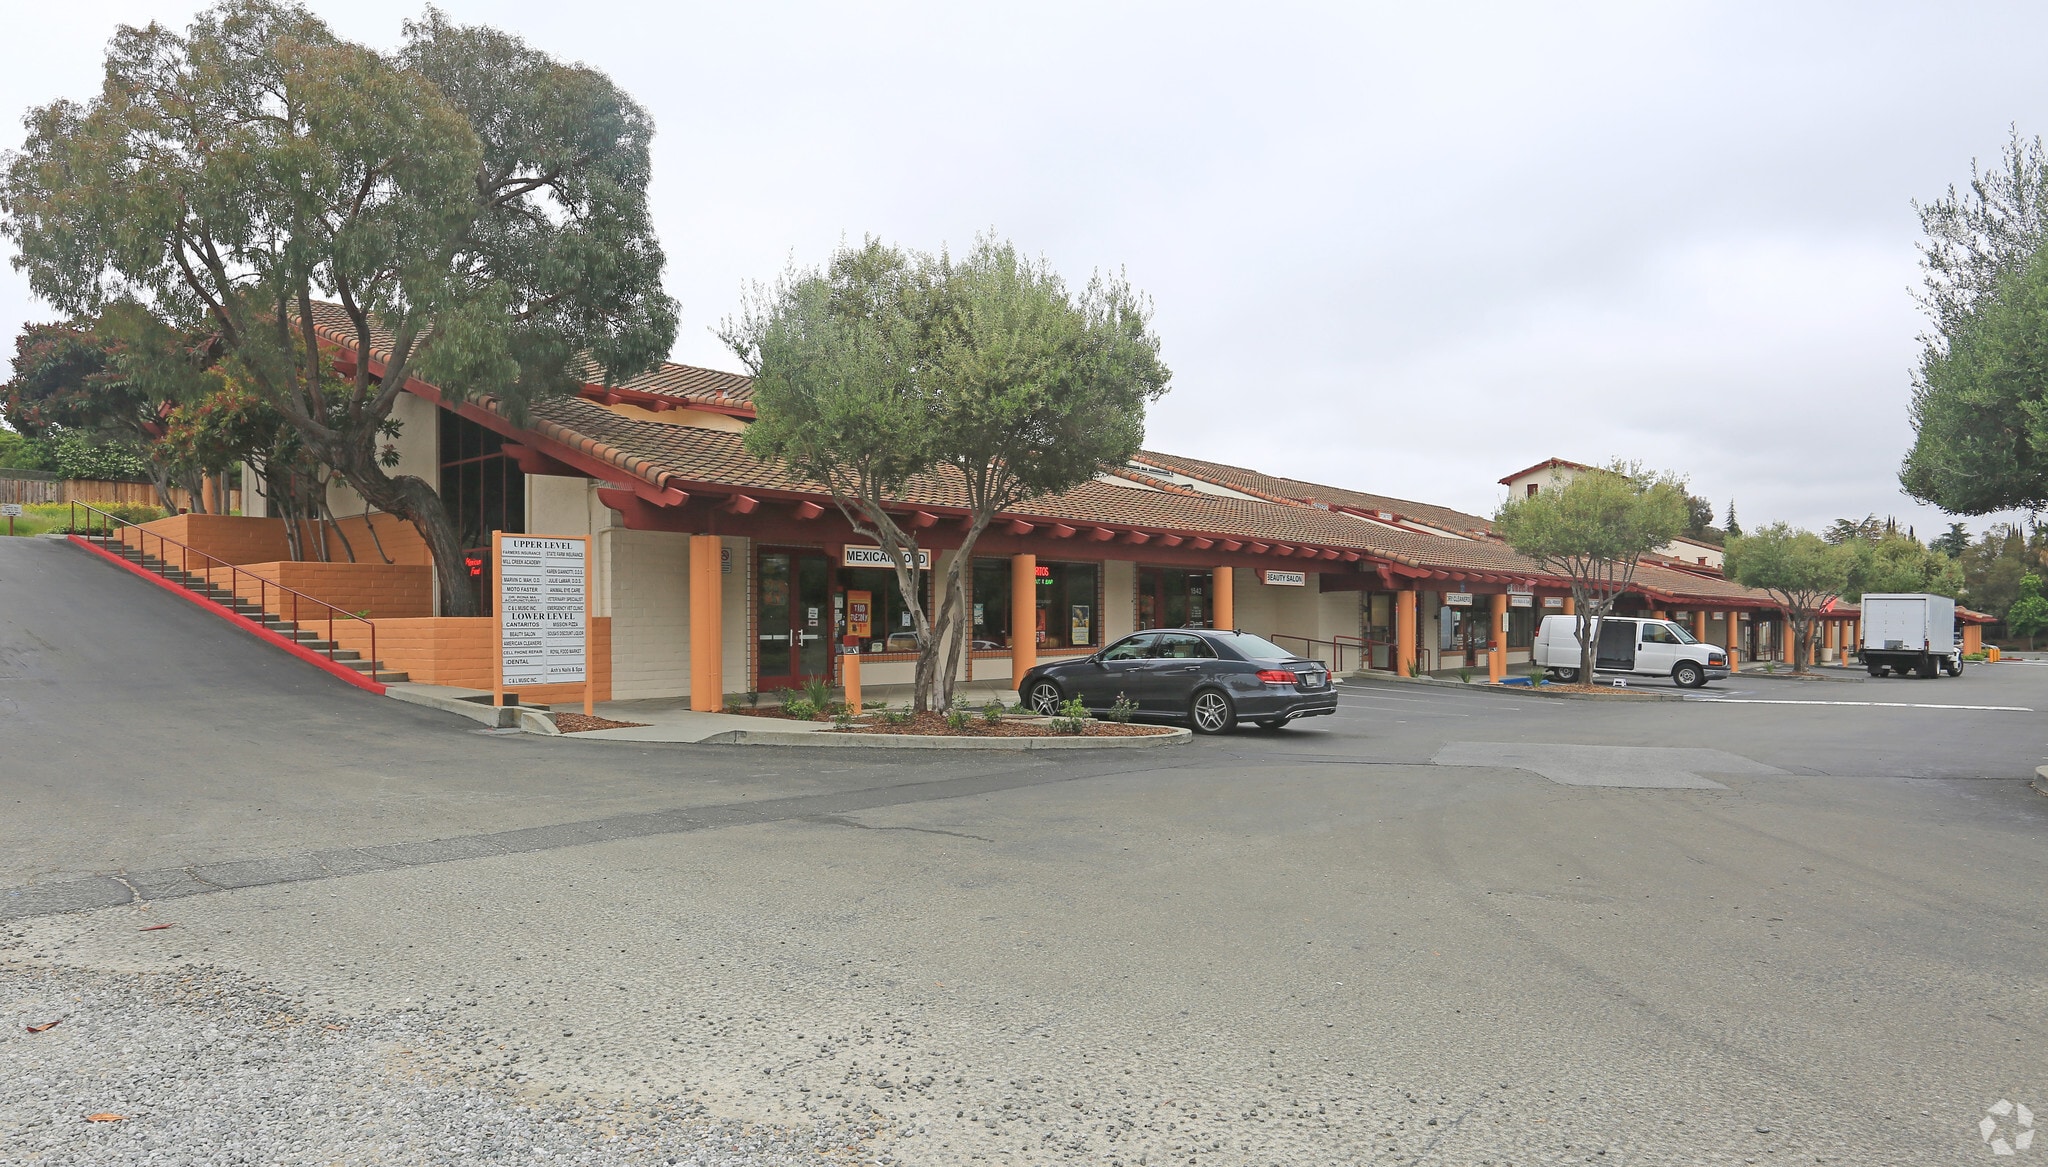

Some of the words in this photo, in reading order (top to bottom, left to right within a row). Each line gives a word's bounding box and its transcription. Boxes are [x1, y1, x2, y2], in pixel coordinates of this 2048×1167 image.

[513, 540, 542, 548] UPPER
[1267, 573, 1286, 581] BEAUTY
[1286, 575, 1302, 583] SALON
